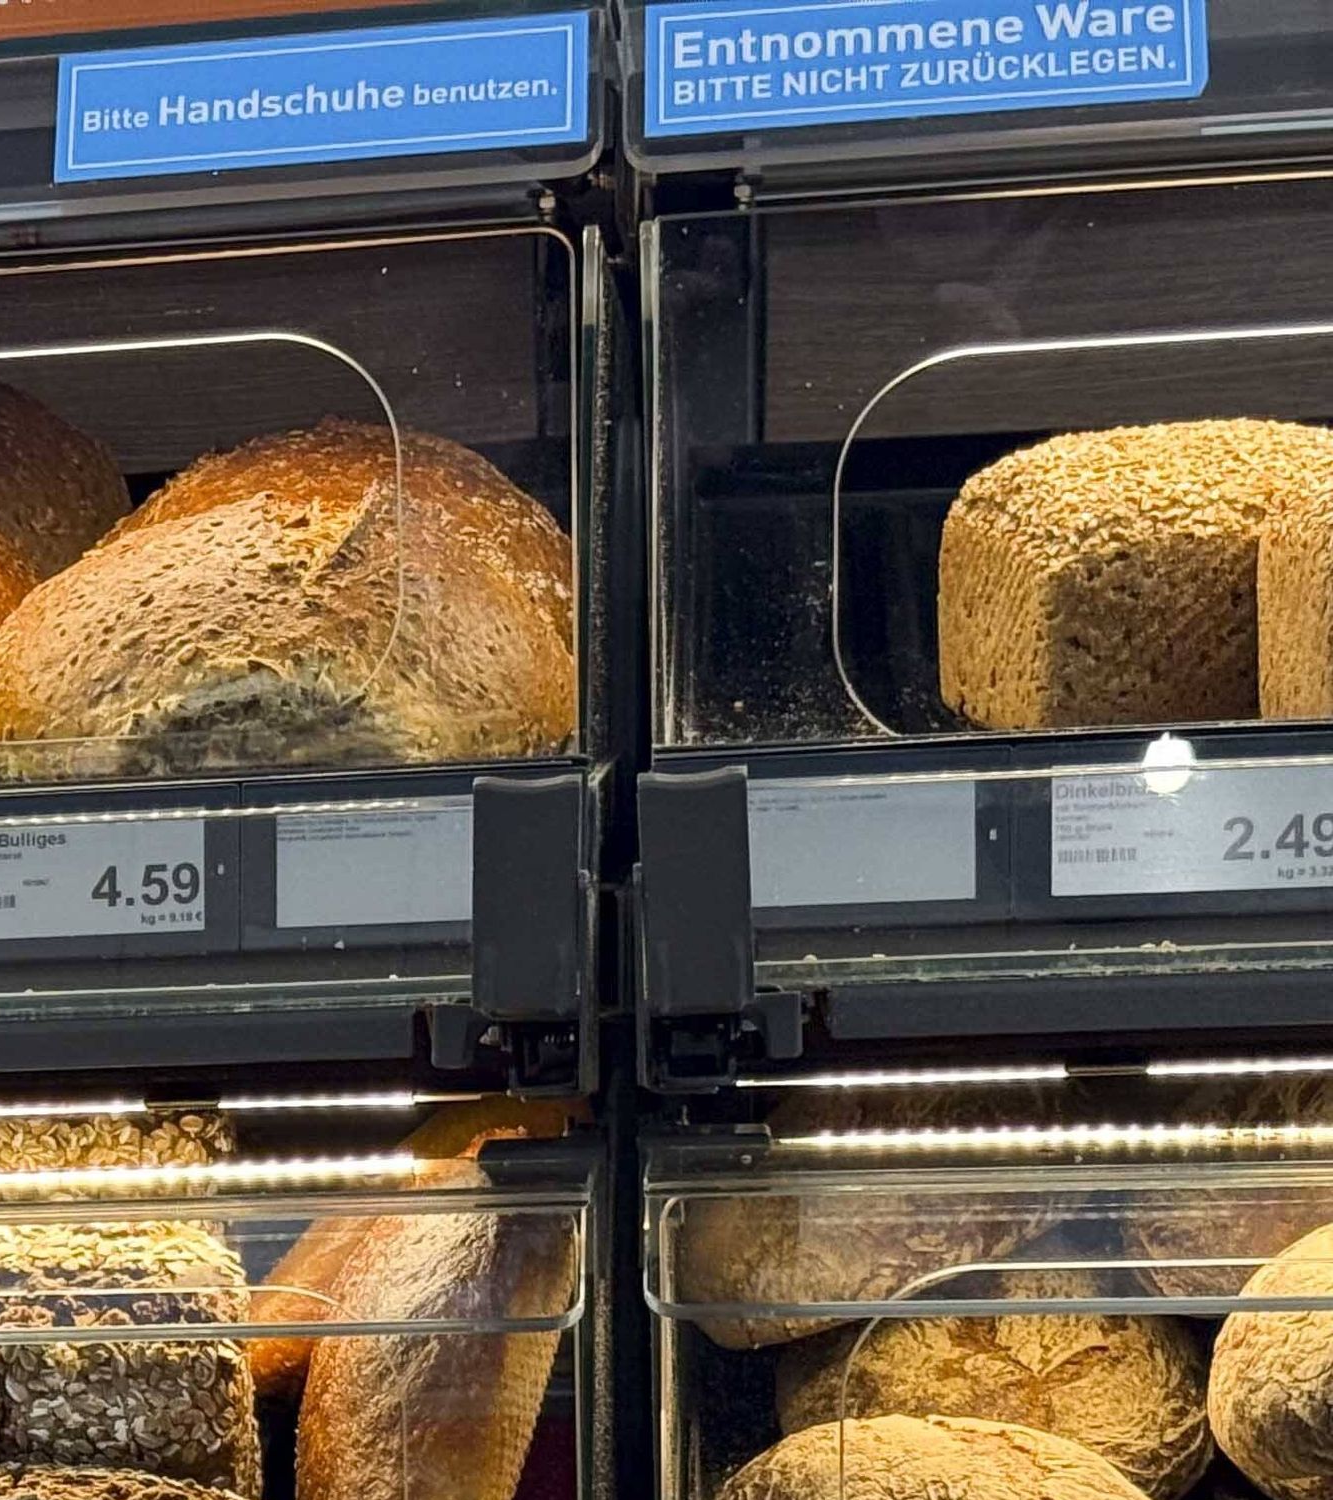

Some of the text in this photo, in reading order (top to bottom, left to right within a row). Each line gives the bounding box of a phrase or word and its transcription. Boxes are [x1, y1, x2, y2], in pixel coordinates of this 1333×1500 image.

[673, 1, 1175, 70] Entnommene Ware
[673, 44, 1176, 106] BITTE NICHT ZURÜCKLEGEN.
[83, 77, 558, 133] Bitte Handschuhe benutzen.
[1222, 813, 1333, 861] 2.49
[91, 862, 201, 907] 4.59
[140, 913, 156, 925] kg
